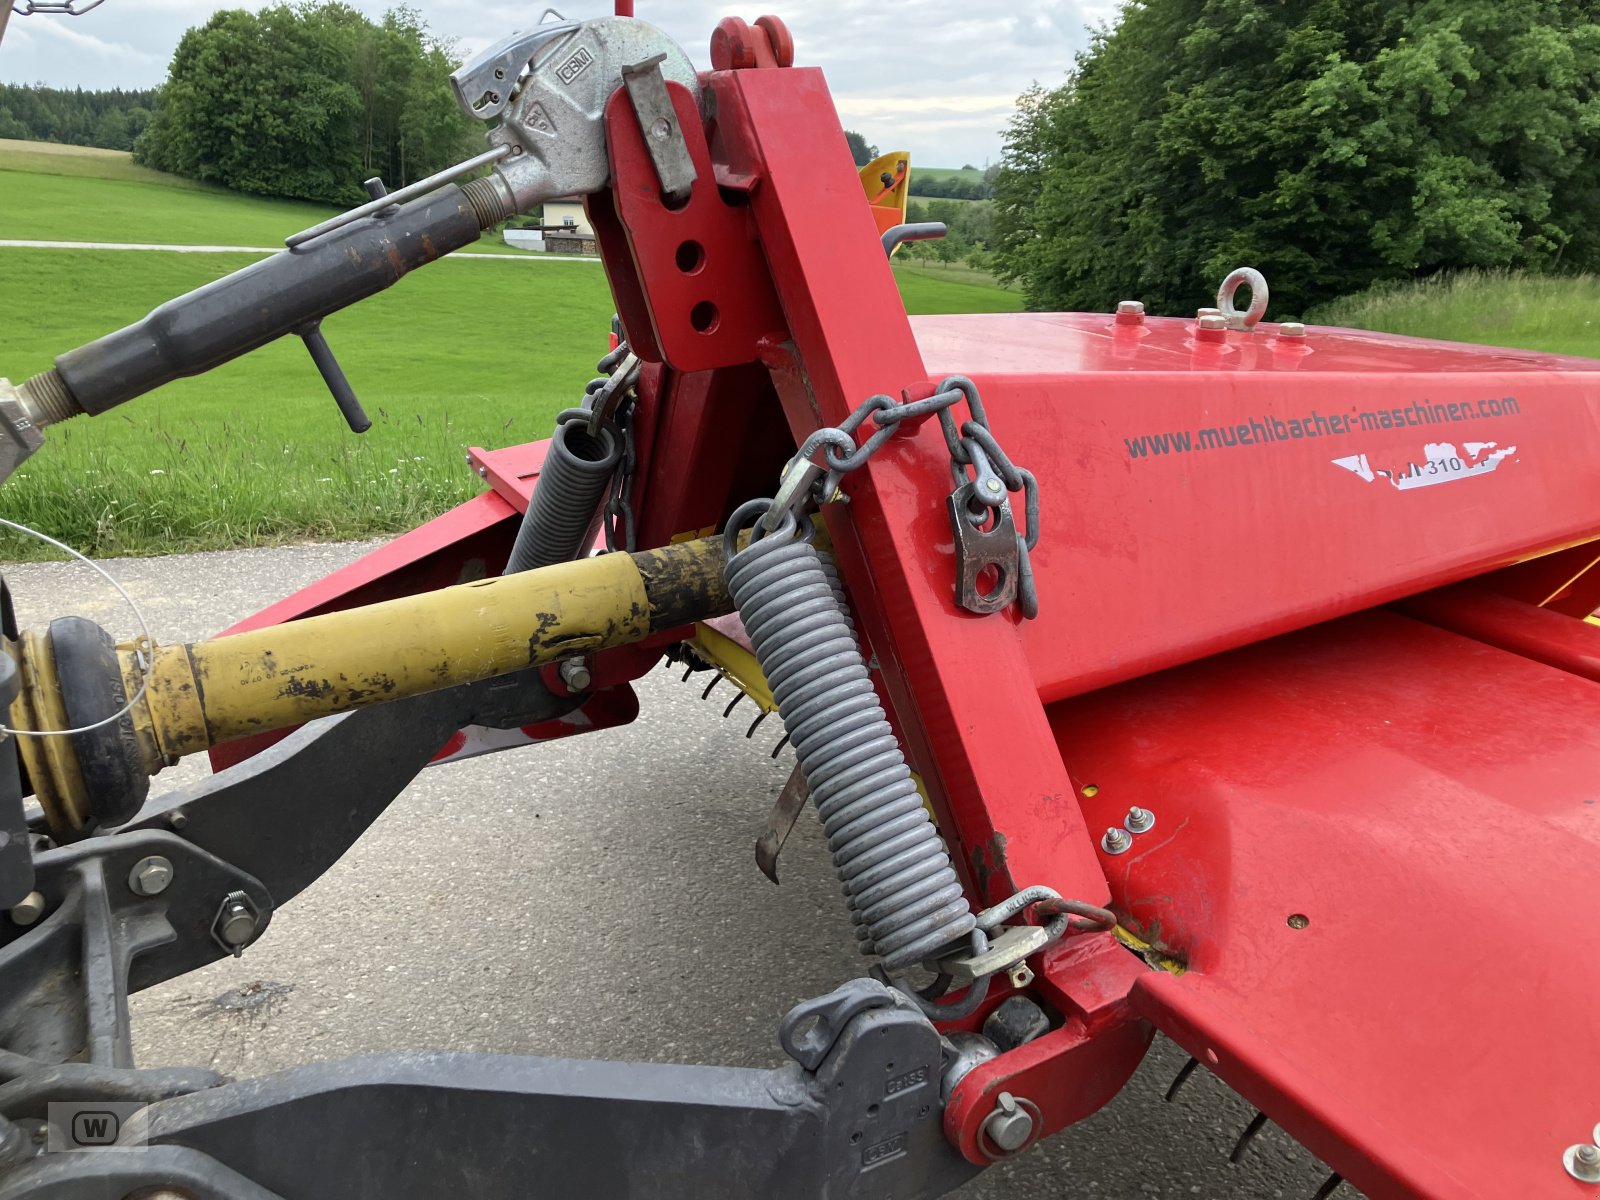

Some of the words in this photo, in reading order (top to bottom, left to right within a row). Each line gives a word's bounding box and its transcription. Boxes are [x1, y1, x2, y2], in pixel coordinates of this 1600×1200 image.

[560, 51, 590, 80] CBM
[1123, 394, 1521, 459] www.muehlbacher-maschinen.com
[1427, 457, 1462, 475] 310
